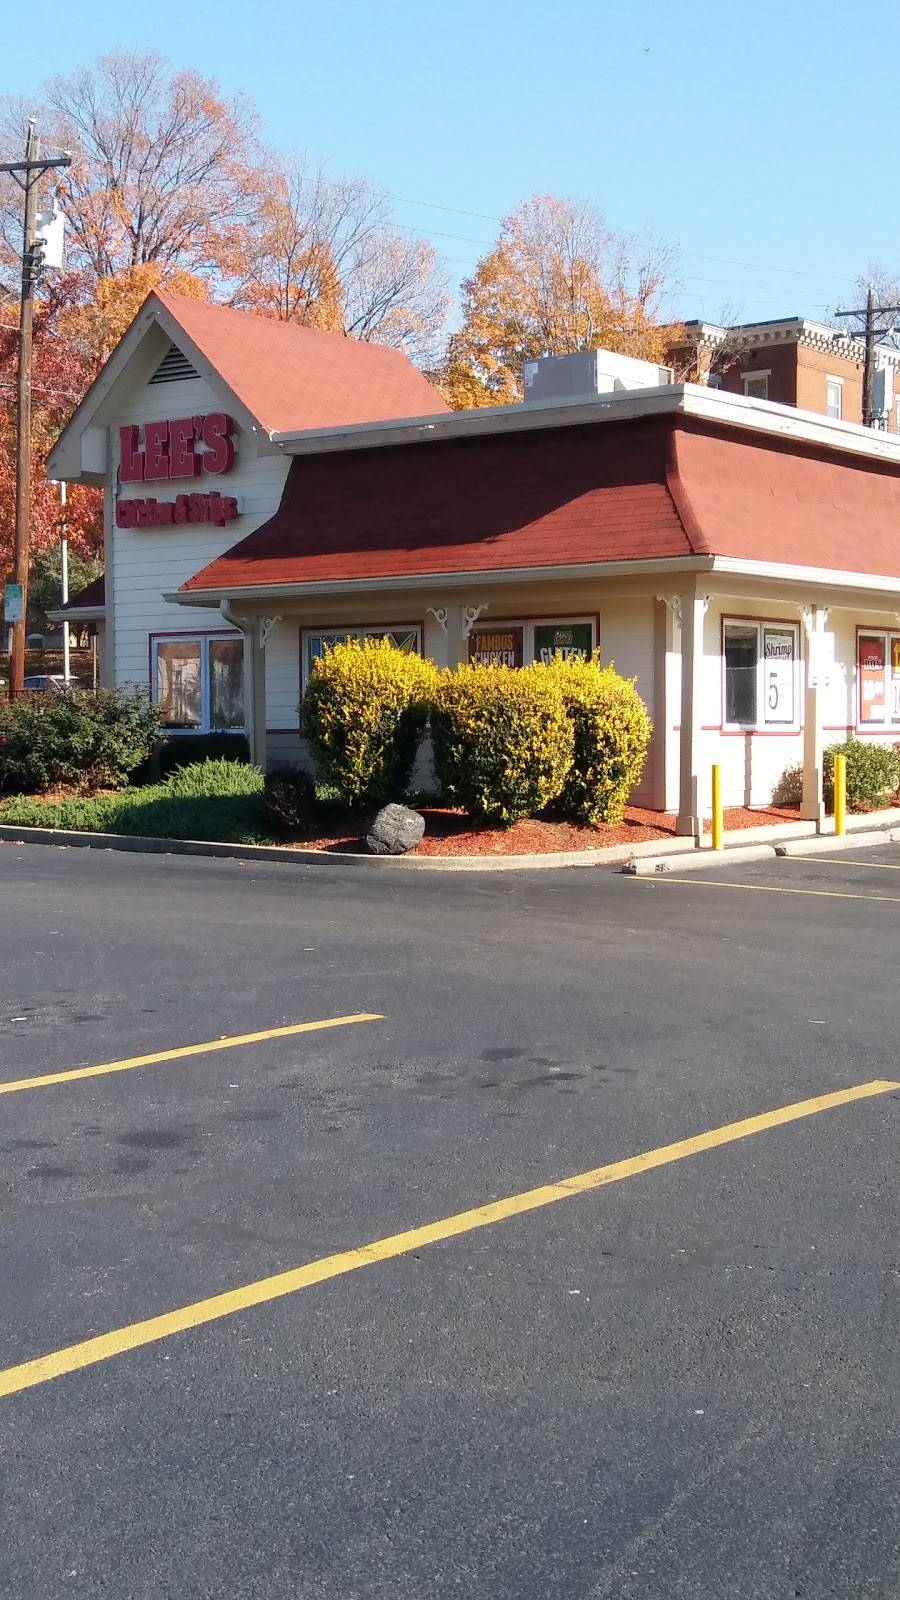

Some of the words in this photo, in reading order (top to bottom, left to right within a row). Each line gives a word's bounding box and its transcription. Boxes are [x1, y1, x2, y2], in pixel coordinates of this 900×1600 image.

[119, 412, 234, 483] LEE'S
[475, 634, 513, 651] FAMOUS
[766, 641, 792, 658] Shrimp
[474, 651, 515, 667] CHICKEN
